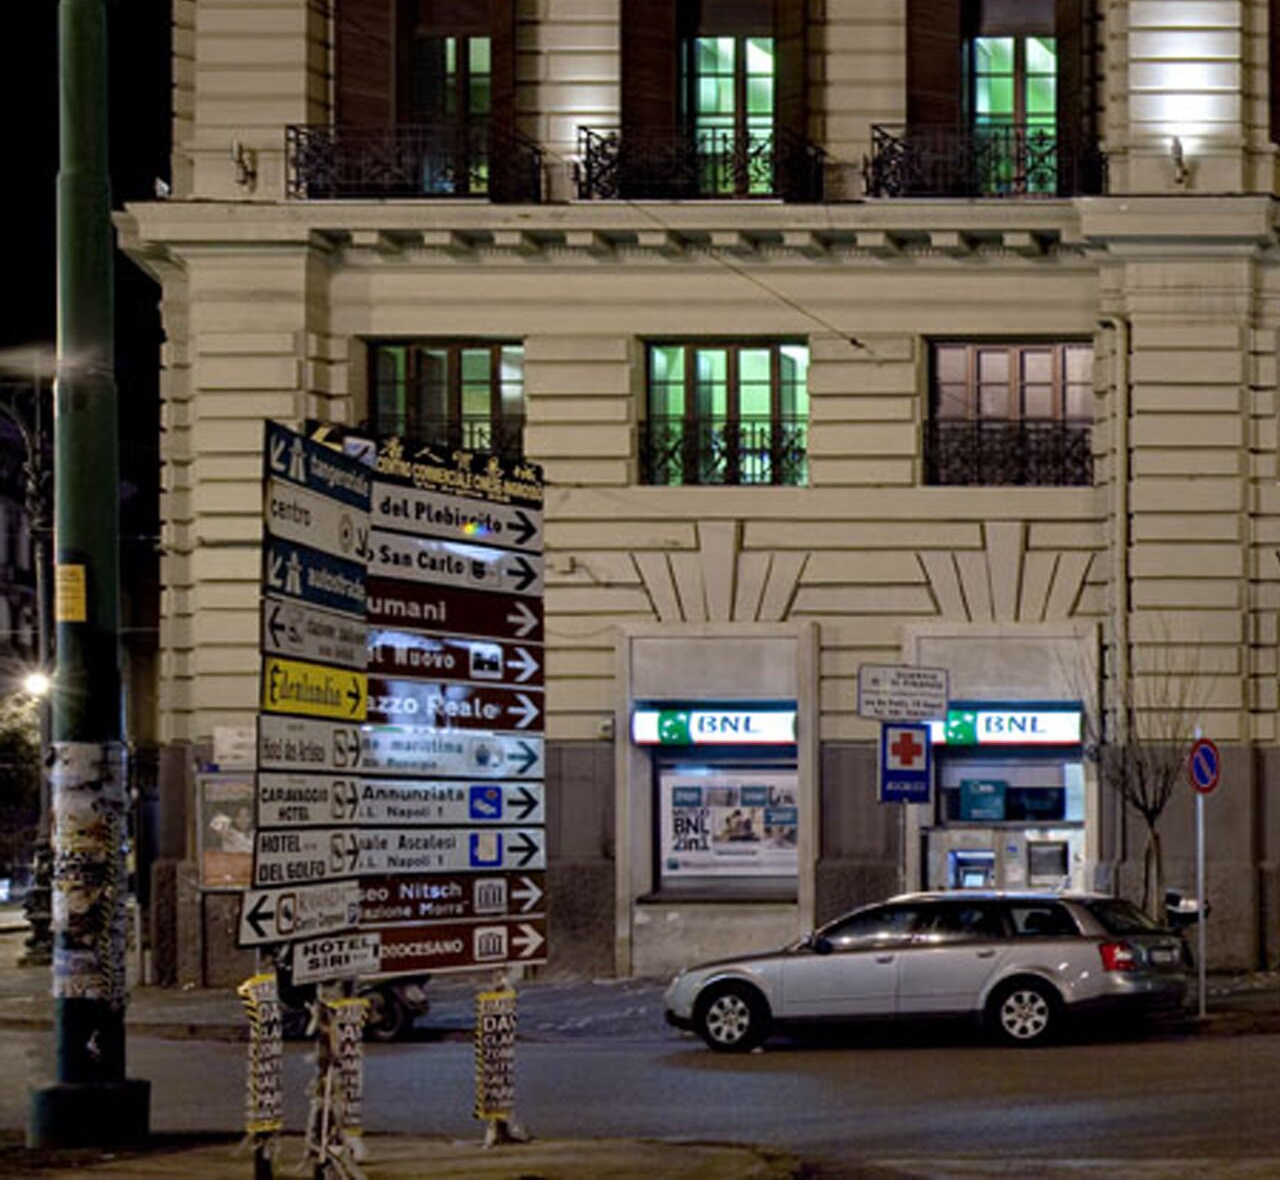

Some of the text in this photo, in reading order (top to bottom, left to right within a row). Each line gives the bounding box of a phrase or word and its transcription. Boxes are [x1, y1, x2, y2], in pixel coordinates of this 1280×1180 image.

[271, 499, 311, 527] centro
[380, 496, 502, 533] del Plebiscito
[380, 545, 465, 575] San Carlo
[426, 693, 500, 720] Reale
[698, 715, 762, 733] BNL
[985, 715, 1048, 733] BNL
[361, 785, 465, 802] Annunziata
[387, 806, 430, 818] Napoli
[673, 817, 710, 834] BNL
[260, 834, 302, 854] HOTEL
[398, 833, 457, 850] Ascalesi
[259, 860, 326, 882] DEL GOLFO
[387, 856, 430, 868] Napoli
[400, 882, 462, 900] Nitsch
[303, 938, 369, 956] HOTEL
